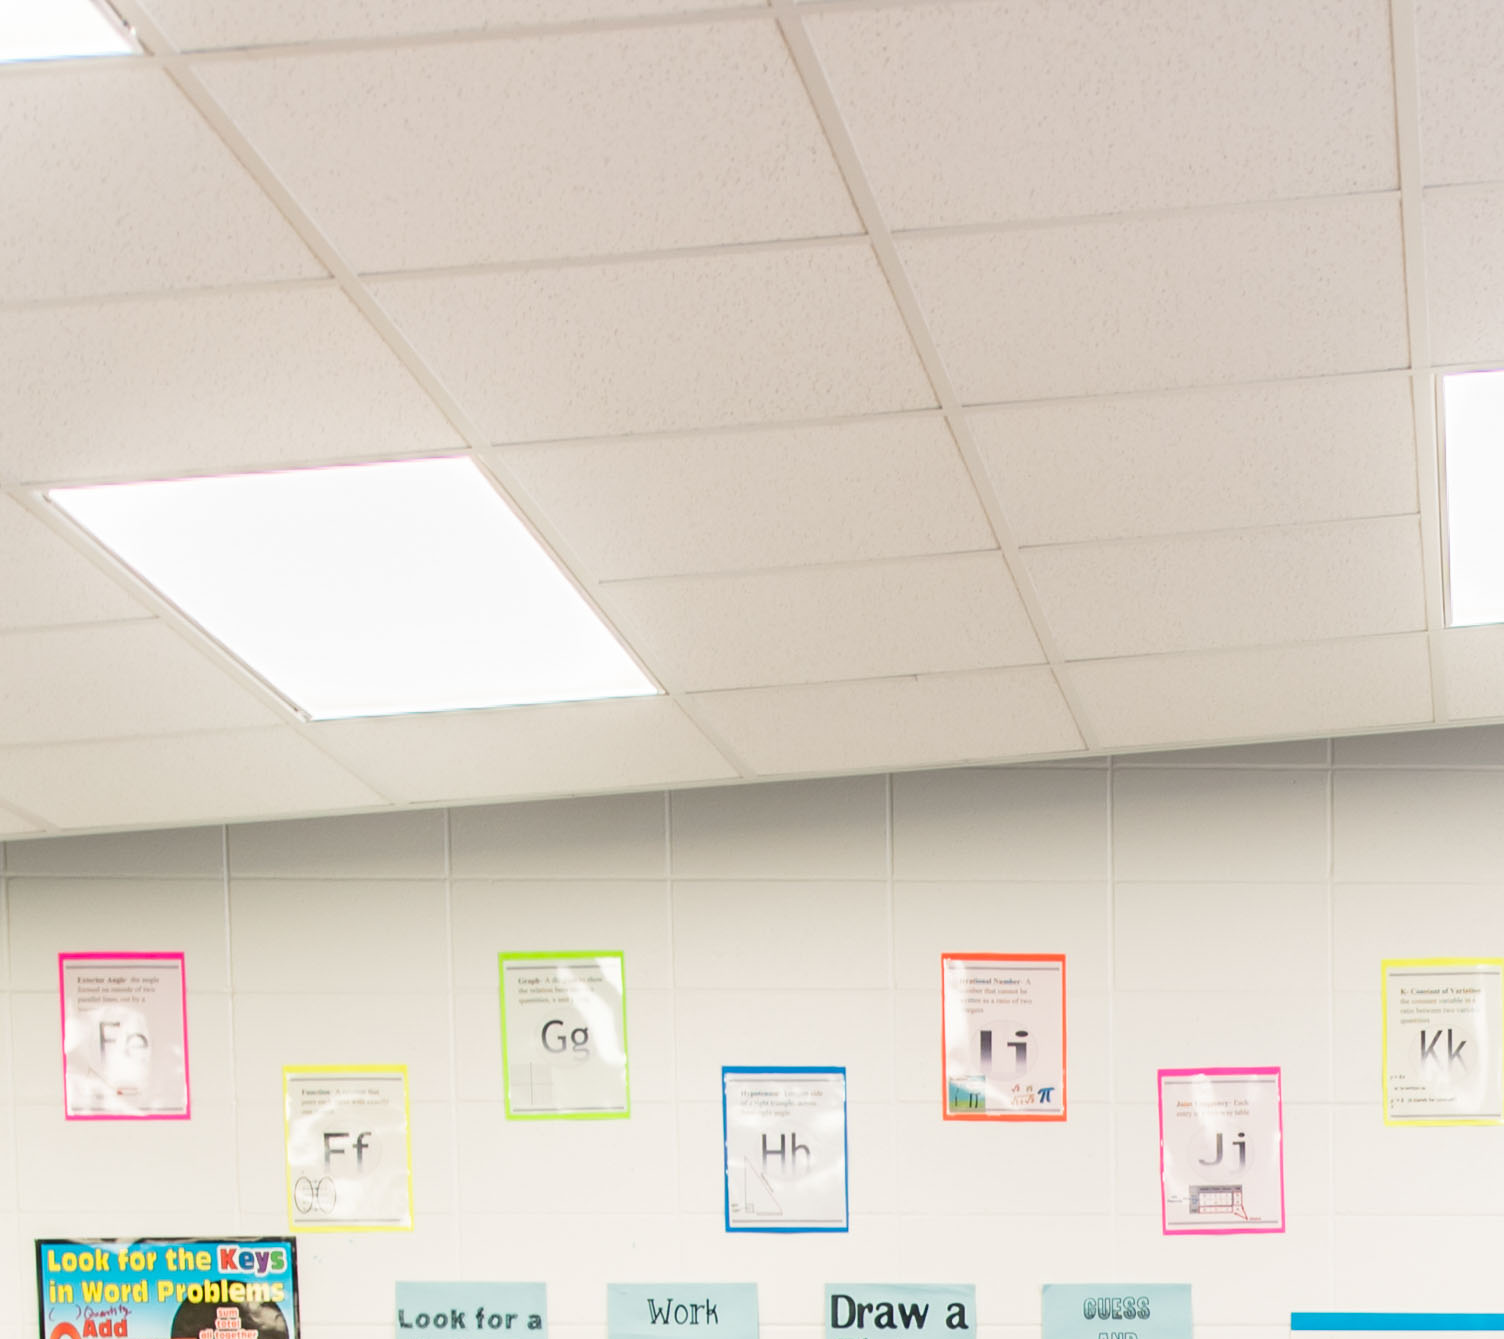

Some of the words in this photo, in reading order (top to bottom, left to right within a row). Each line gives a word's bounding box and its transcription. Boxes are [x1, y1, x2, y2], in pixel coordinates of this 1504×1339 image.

[540, 1019, 591, 1060] Gg
[1420, 1028, 1468, 1065] Kk
[322, 1131, 372, 1174] Ff
[761, 1132, 811, 1174] Hh
[48, 1250, 109, 1271] Look
[118, 1248, 156, 1271] for
[167, 1247, 211, 1271] the
[220, 1248, 285, 1273] Keys
[49, 1281, 73, 1303] in
[82, 1281, 148, 1303] Word
[158, 1279, 285, 1303] Problems
[398, 1309, 466, 1331] Look
[475, 1308, 517, 1331] for
[528, 1314, 542, 1329] a
[647, 1298, 719, 1325] Work
[831, 1294, 930, 1329] Draw
[946, 1301, 968, 1329] a
[1083, 1297, 1150, 1320] GUESS
[83, 1319, 128, 1338] Add
